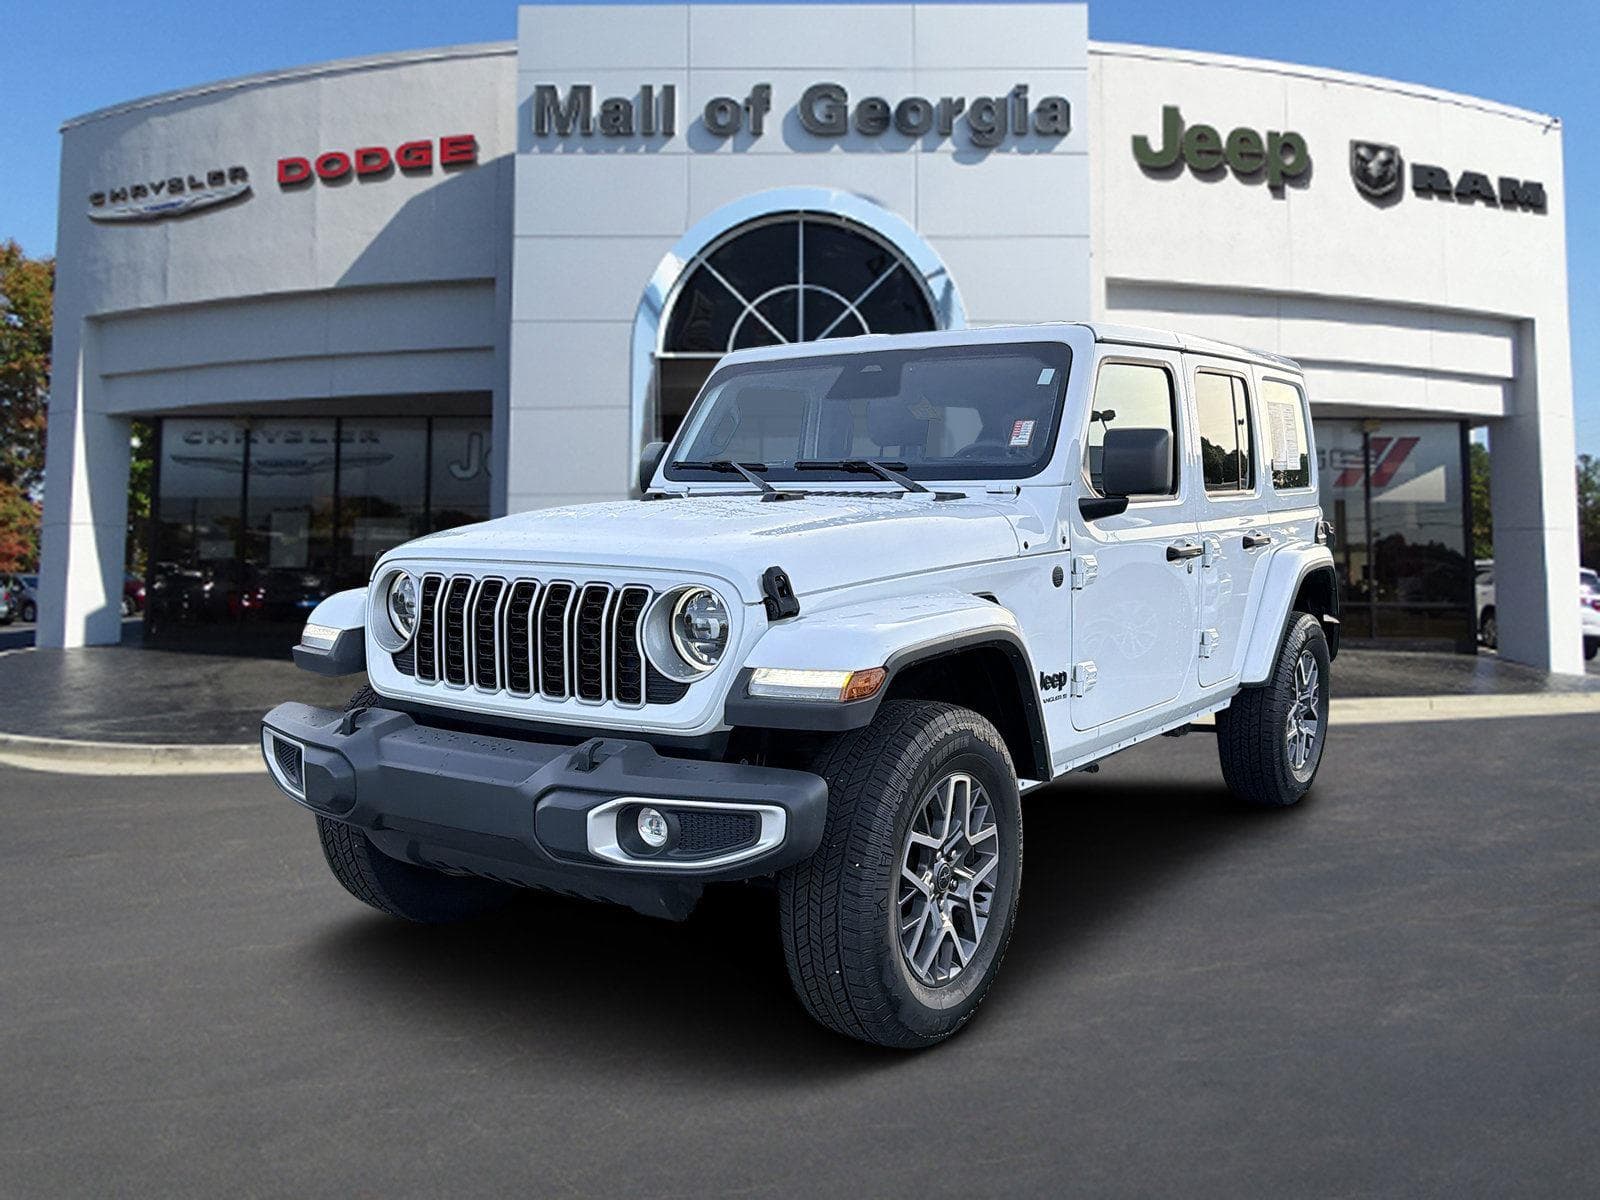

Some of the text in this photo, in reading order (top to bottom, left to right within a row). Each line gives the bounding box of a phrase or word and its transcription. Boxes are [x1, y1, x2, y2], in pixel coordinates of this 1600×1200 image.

[533, 82, 1071, 148] Mall of Georgia
[277, 135, 477, 186] DODGE
[1132, 105, 1309, 191] Jeep
[89, 166, 248, 207] CHRYSLER
[1411, 163, 1547, 211] RAM
